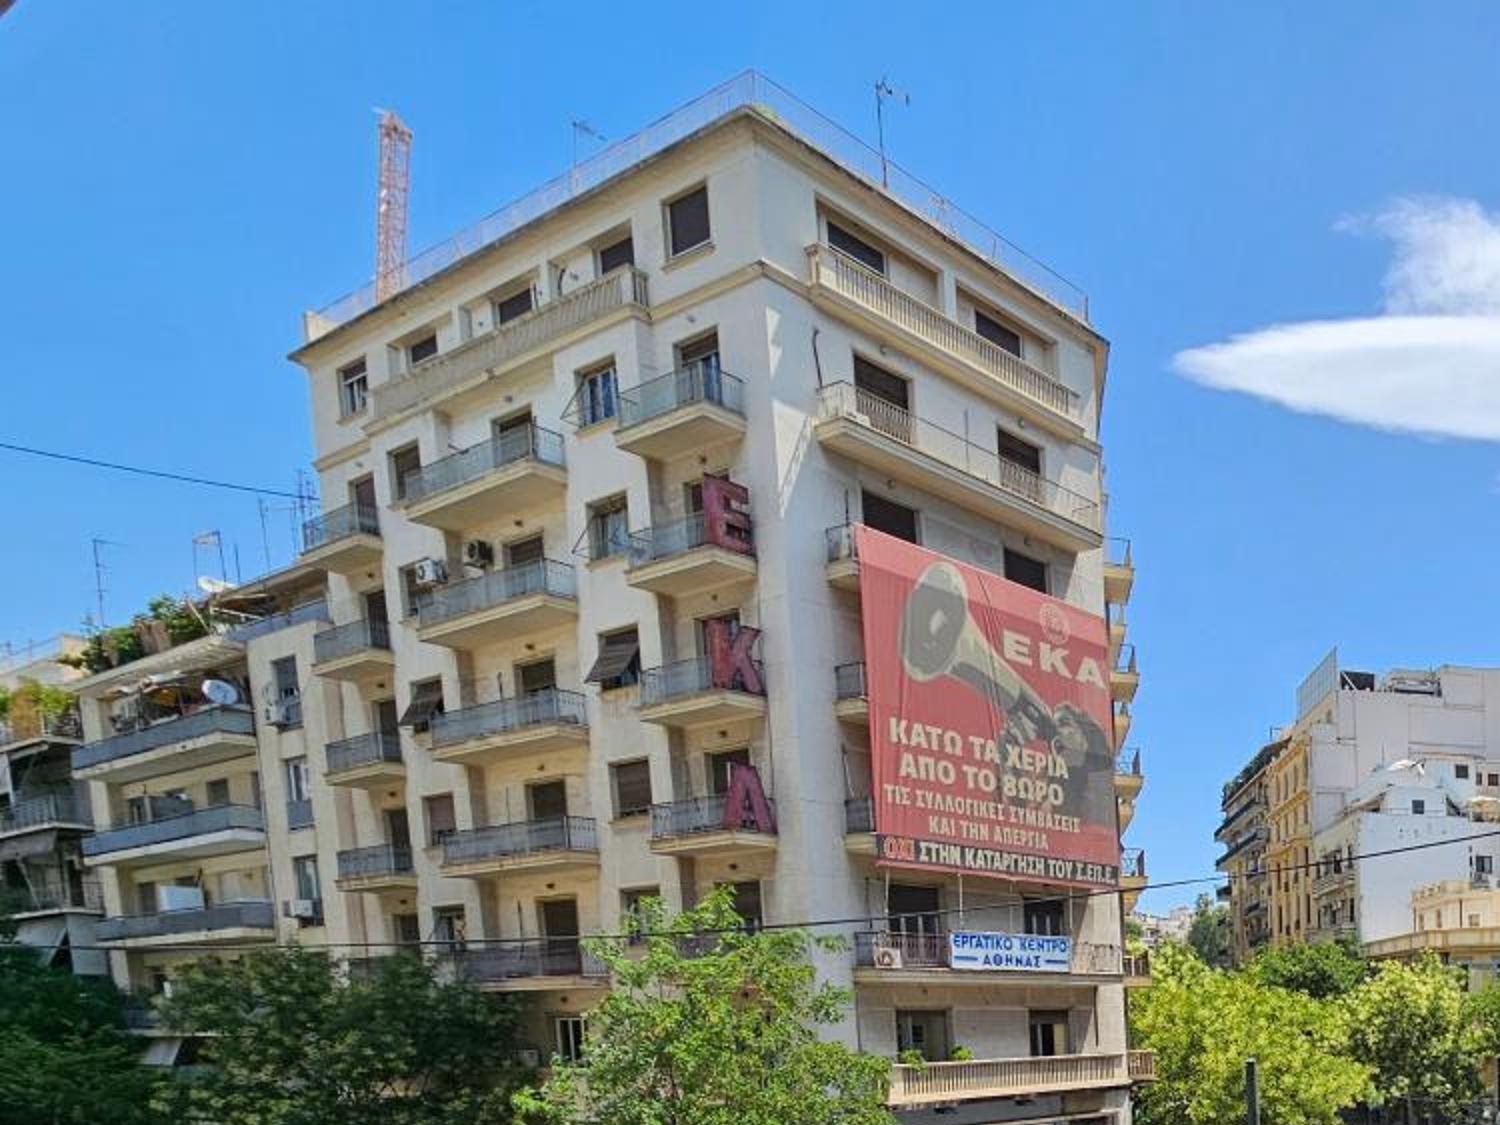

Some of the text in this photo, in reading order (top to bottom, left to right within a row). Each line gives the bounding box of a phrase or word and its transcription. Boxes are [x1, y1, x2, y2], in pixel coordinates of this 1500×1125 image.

[1003, 629, 1107, 690] ΕΚΑ
[889, 717, 1069, 779] ΚΑΤΩ ΤΑ ΧΕΡΙΑ
[899, 752, 1064, 806] ΑΠΟ ΤΟ 8ΩΡΟ
[884, 784, 1080, 833] ΤΙΣ ΣΥΛΛΟΓΙΚΕΣ ΣΥΜΒΑΣΕΙΣ
[929, 816, 1049, 850] ΚΑΙ ΤΗΝ ΑΠΕΡΓΙΑ
[919, 841, 961, 866] ΣΤΗΝ
[965, 847, 1045, 877] ΚΑΤΑΡΓΗΣΗ
[1048, 859, 1073, 879] ΤΟΥ
[953, 933, 1067, 953] ΕΡΓΑΤΙΚΟ ΚΕΝΤΡΟ
[982, 954, 1041, 968] ΑΘΗΝΑΣ
